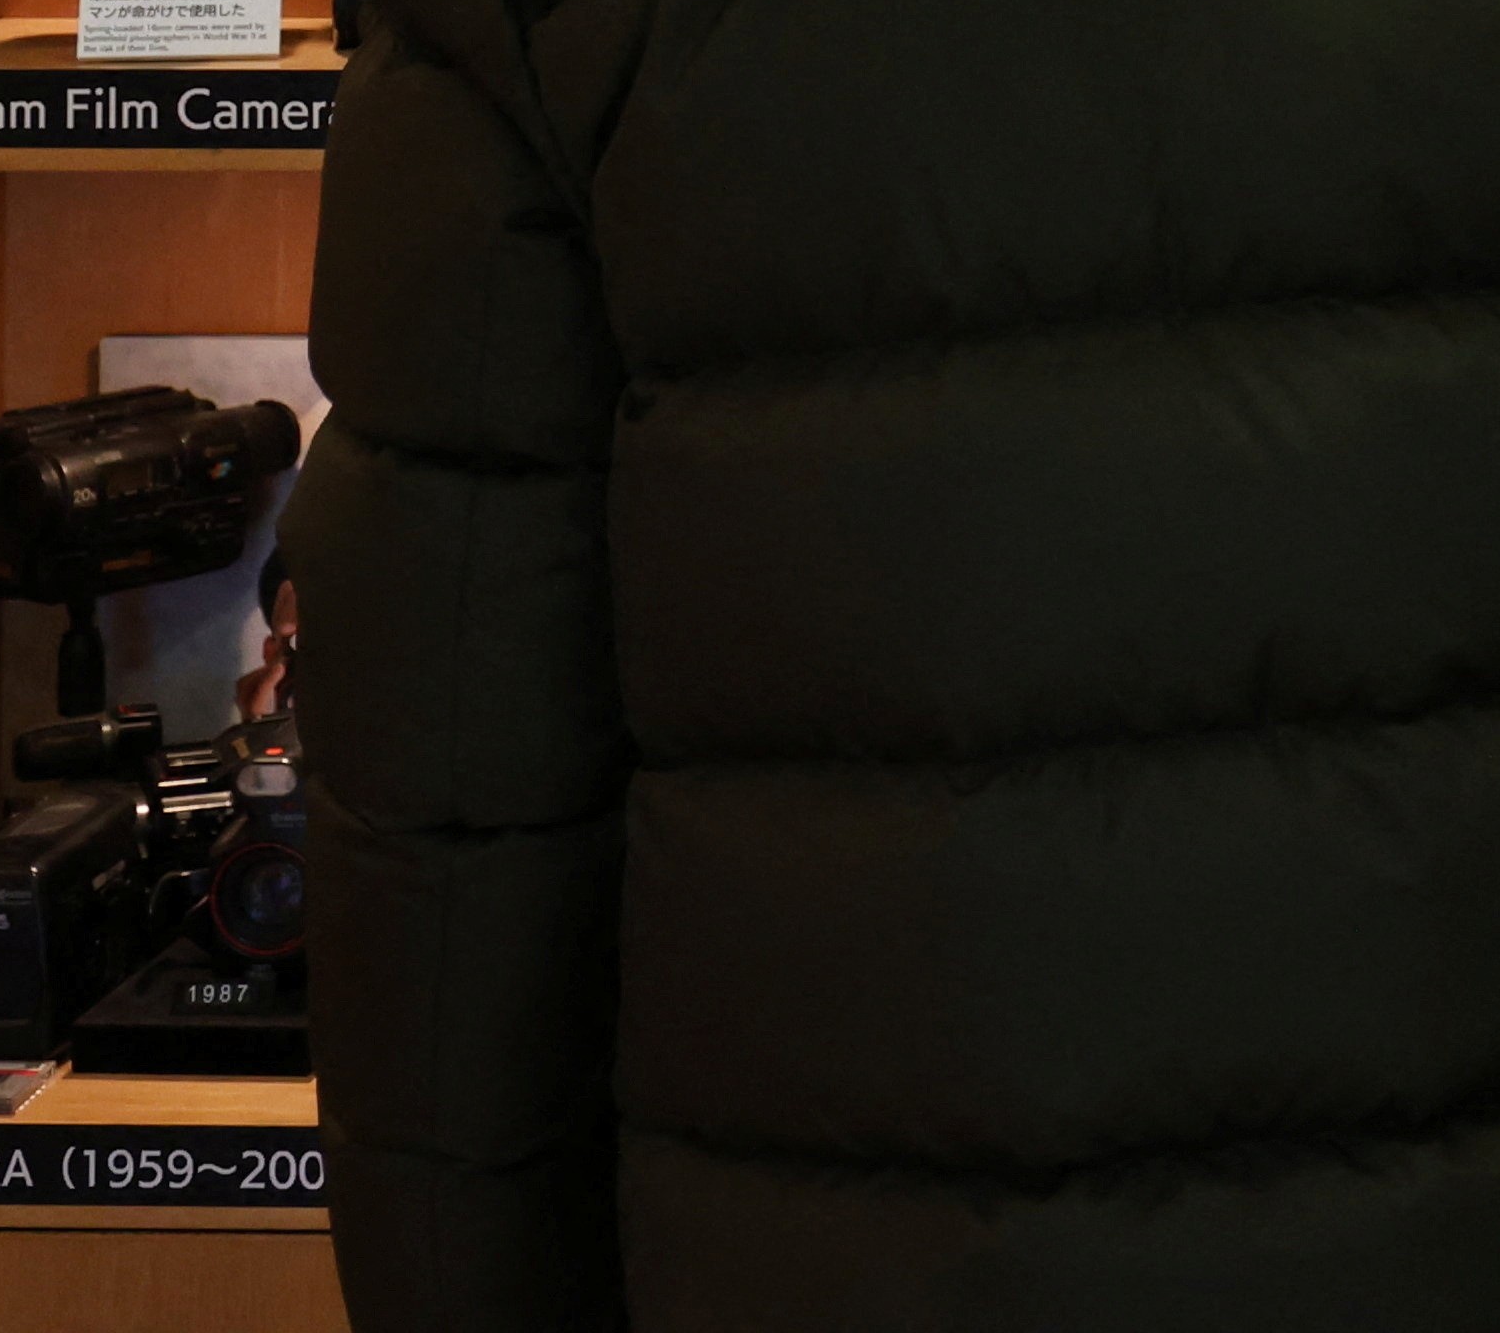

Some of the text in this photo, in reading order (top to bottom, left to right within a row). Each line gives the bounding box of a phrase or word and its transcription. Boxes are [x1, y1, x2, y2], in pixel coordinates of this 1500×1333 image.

[89, 4, 246, 19] マンが命がけで使用した
[65, 86, 159, 131] Film
[187, 983, 250, 1004] 1987
